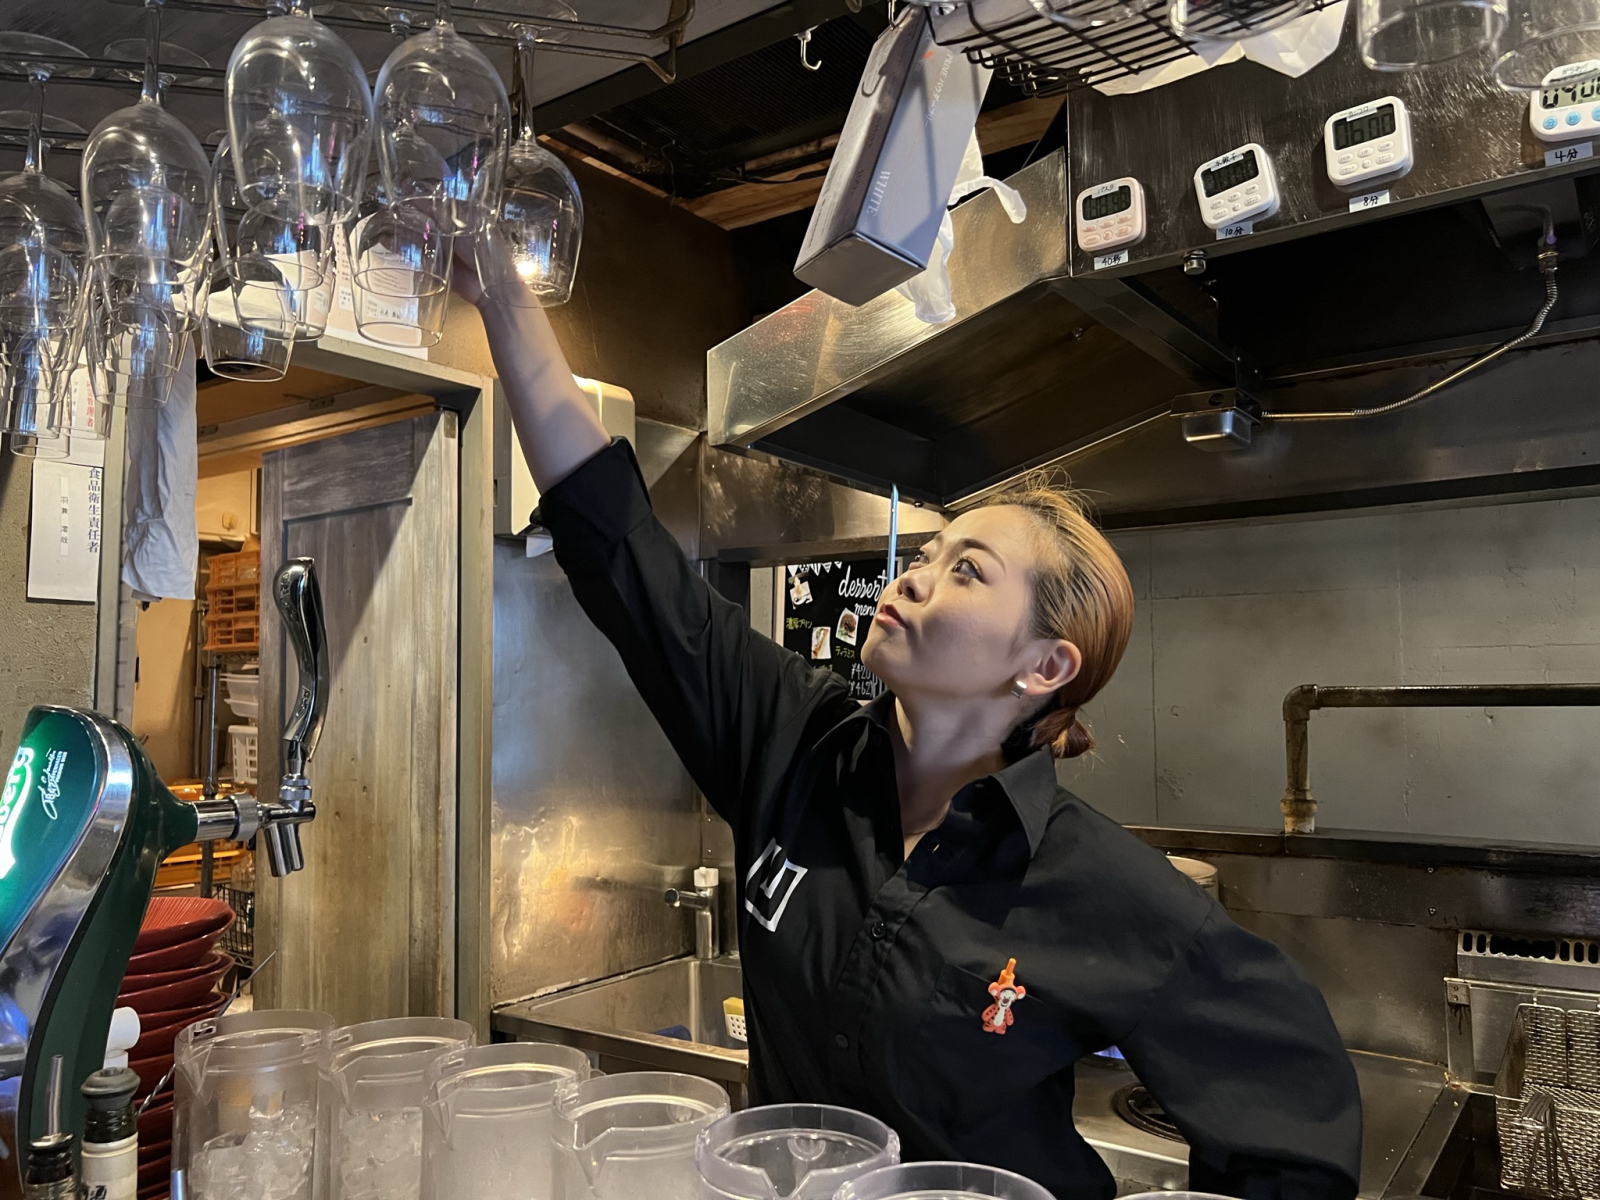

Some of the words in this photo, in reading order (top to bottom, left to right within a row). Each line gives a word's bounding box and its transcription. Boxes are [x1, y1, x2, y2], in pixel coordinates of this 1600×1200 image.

[1555, 148, 1578, 162] 4分
[866, 170, 891, 217] WHITE
[1363, 195, 1379, 206] 8分
[1225, 226, 1244, 236] 10分
[1101, 254, 1121, 266] 40秒
[87, 466, 101, 553] 食品衛生責任者
[838, 565, 888, 602] dessert
